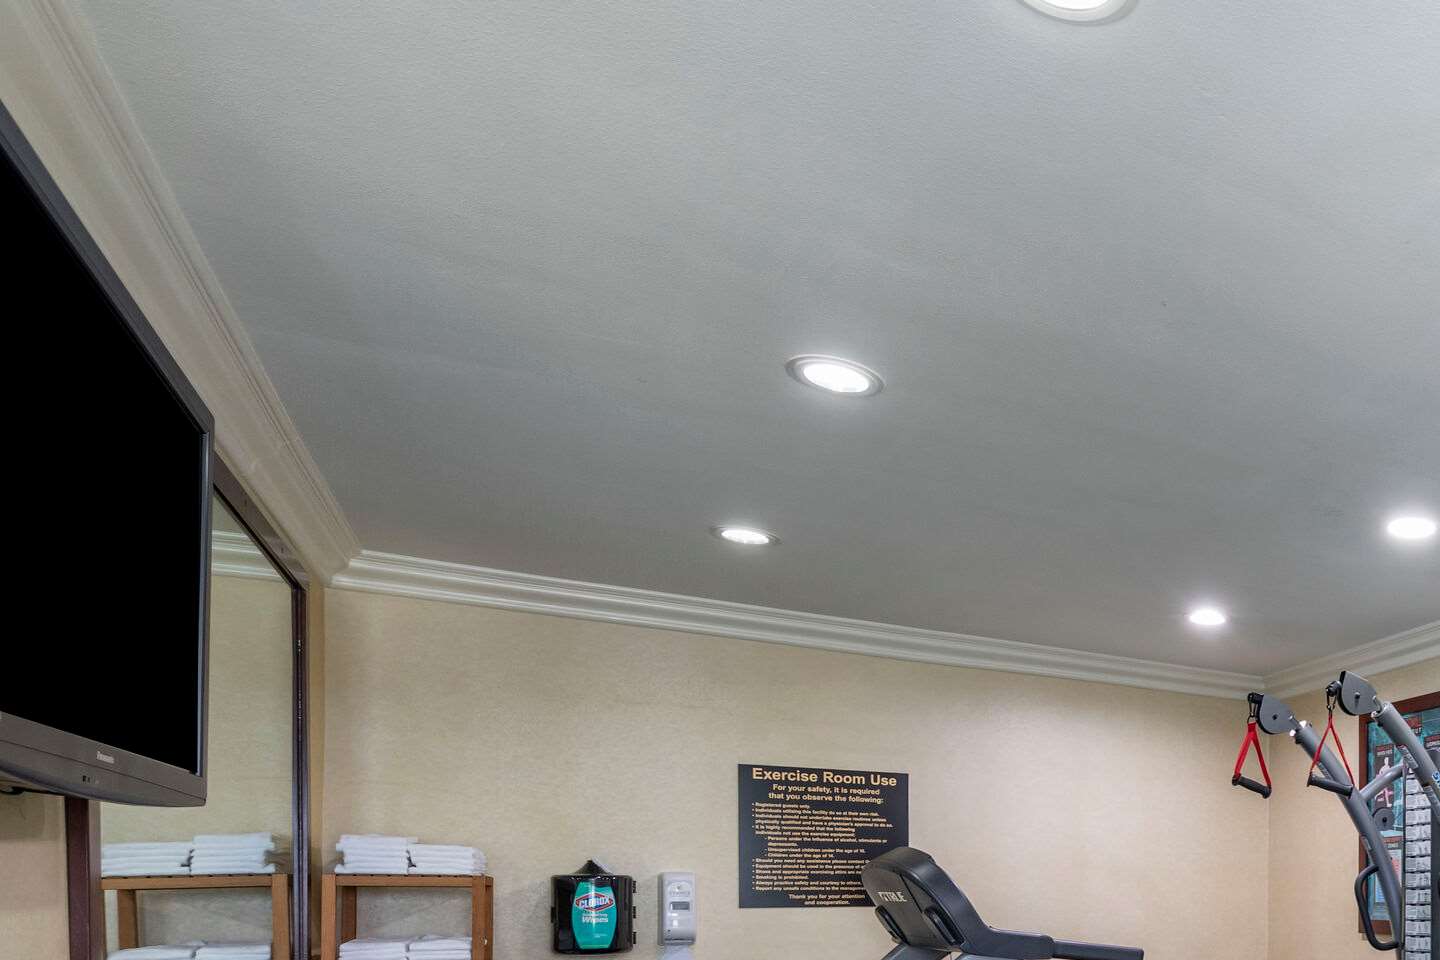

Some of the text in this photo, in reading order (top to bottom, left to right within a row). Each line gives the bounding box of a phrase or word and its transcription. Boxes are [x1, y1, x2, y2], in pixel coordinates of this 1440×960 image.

[752, 767, 897, 786] Exercise Room Use
